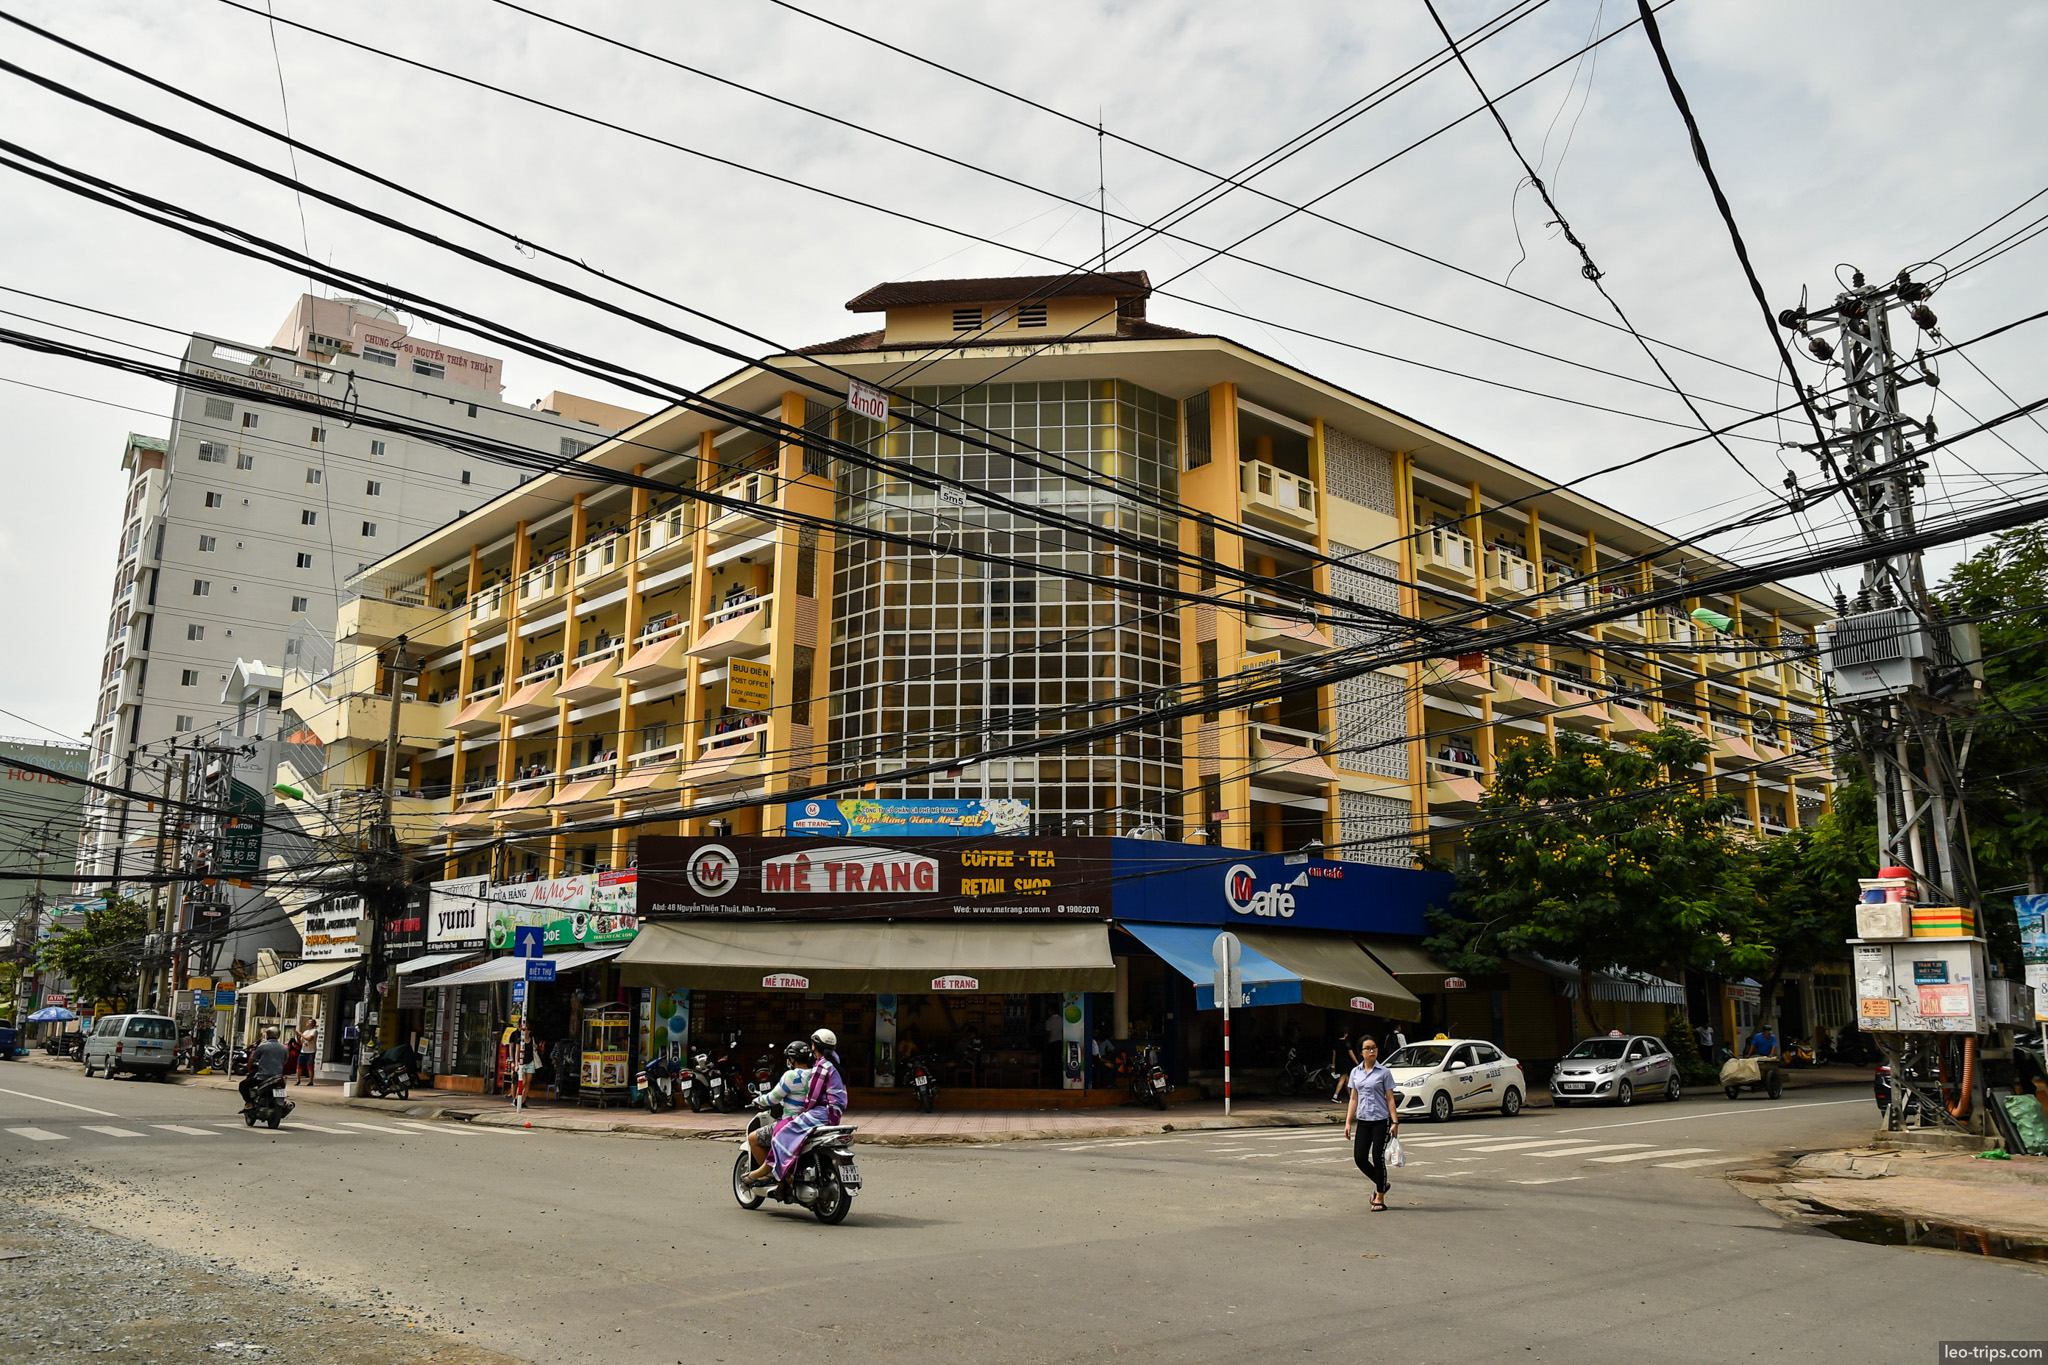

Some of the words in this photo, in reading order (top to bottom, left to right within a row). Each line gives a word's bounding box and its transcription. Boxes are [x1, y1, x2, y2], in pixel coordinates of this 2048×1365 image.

[364, 333, 390, 348] CHUNG
[404, 344, 414, 354] 60
[415, 346, 445, 362] NGUYỄN
[447, 355, 468, 369] THIỆN
[470, 360, 494, 374] THUẬT
[249, 367, 281, 382] HOTEL
[851, 391, 884, 418] 4m00
[943, 492, 964, 505] 5m5
[733, 663, 749, 674] BƯU
[731, 676, 747, 685] POST
[748, 679, 769, 689] OFFICE
[862, 806, 877, 814] CÔNG
[940, 806, 958, 814] TRANG
[958, 814, 988, 825] 2017
[960, 849, 1015, 868] COFFEE
[1028, 850, 1056, 868] TEA
[766, 853, 812, 892] MÊ
[823, 861, 934, 892] TRANG
[1323, 866, 1344, 879] café
[960, 878, 1006, 896] RETAIL
[1013, 878, 1052, 896] SHOP
[1224, 864, 1296, 918] Café
[508, 887, 527, 901] HÀNG
[652, 903, 667, 911] Abd:
[667, 903, 676, 911] 48
[676, 902, 701, 913] Nguyễn
[701, 904, 719, 914] Thiện
[742, 905, 755, 913] Nha
[953, 905, 972, 914] Wed:
[973, 905, 1051, 915] www.metrang.com.vn
[1065, 905, 1100, 914] 19002070
[437, 901, 477, 937] yumi
[765, 975, 777, 986] MÊ
[780, 977, 807, 988] TRANG
[934, 977, 946, 989] MÊ
[949, 979, 976, 989] TRANG
[1359, 1000, 1373, 1011] TRANG
